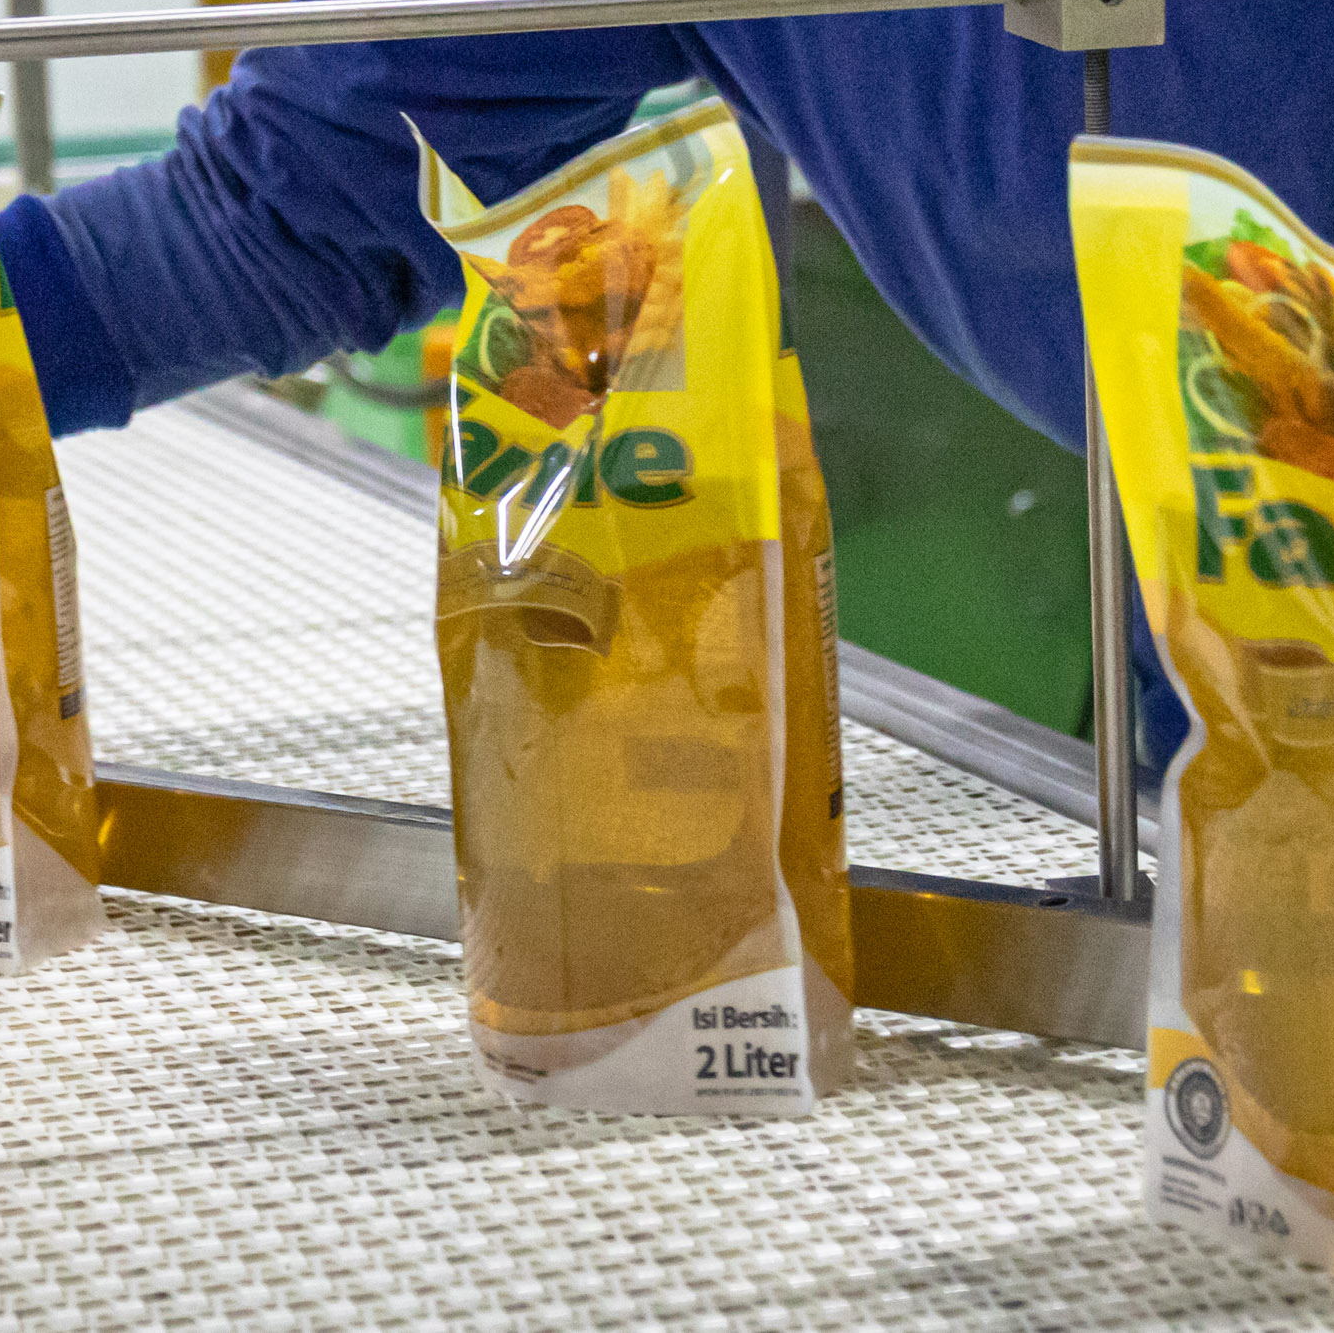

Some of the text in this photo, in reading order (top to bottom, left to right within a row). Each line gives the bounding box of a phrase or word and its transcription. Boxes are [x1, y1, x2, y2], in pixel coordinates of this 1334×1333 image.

[693, 1006, 717, 1030] Isi
[696, 1042, 799, 1079] 2 Liter
